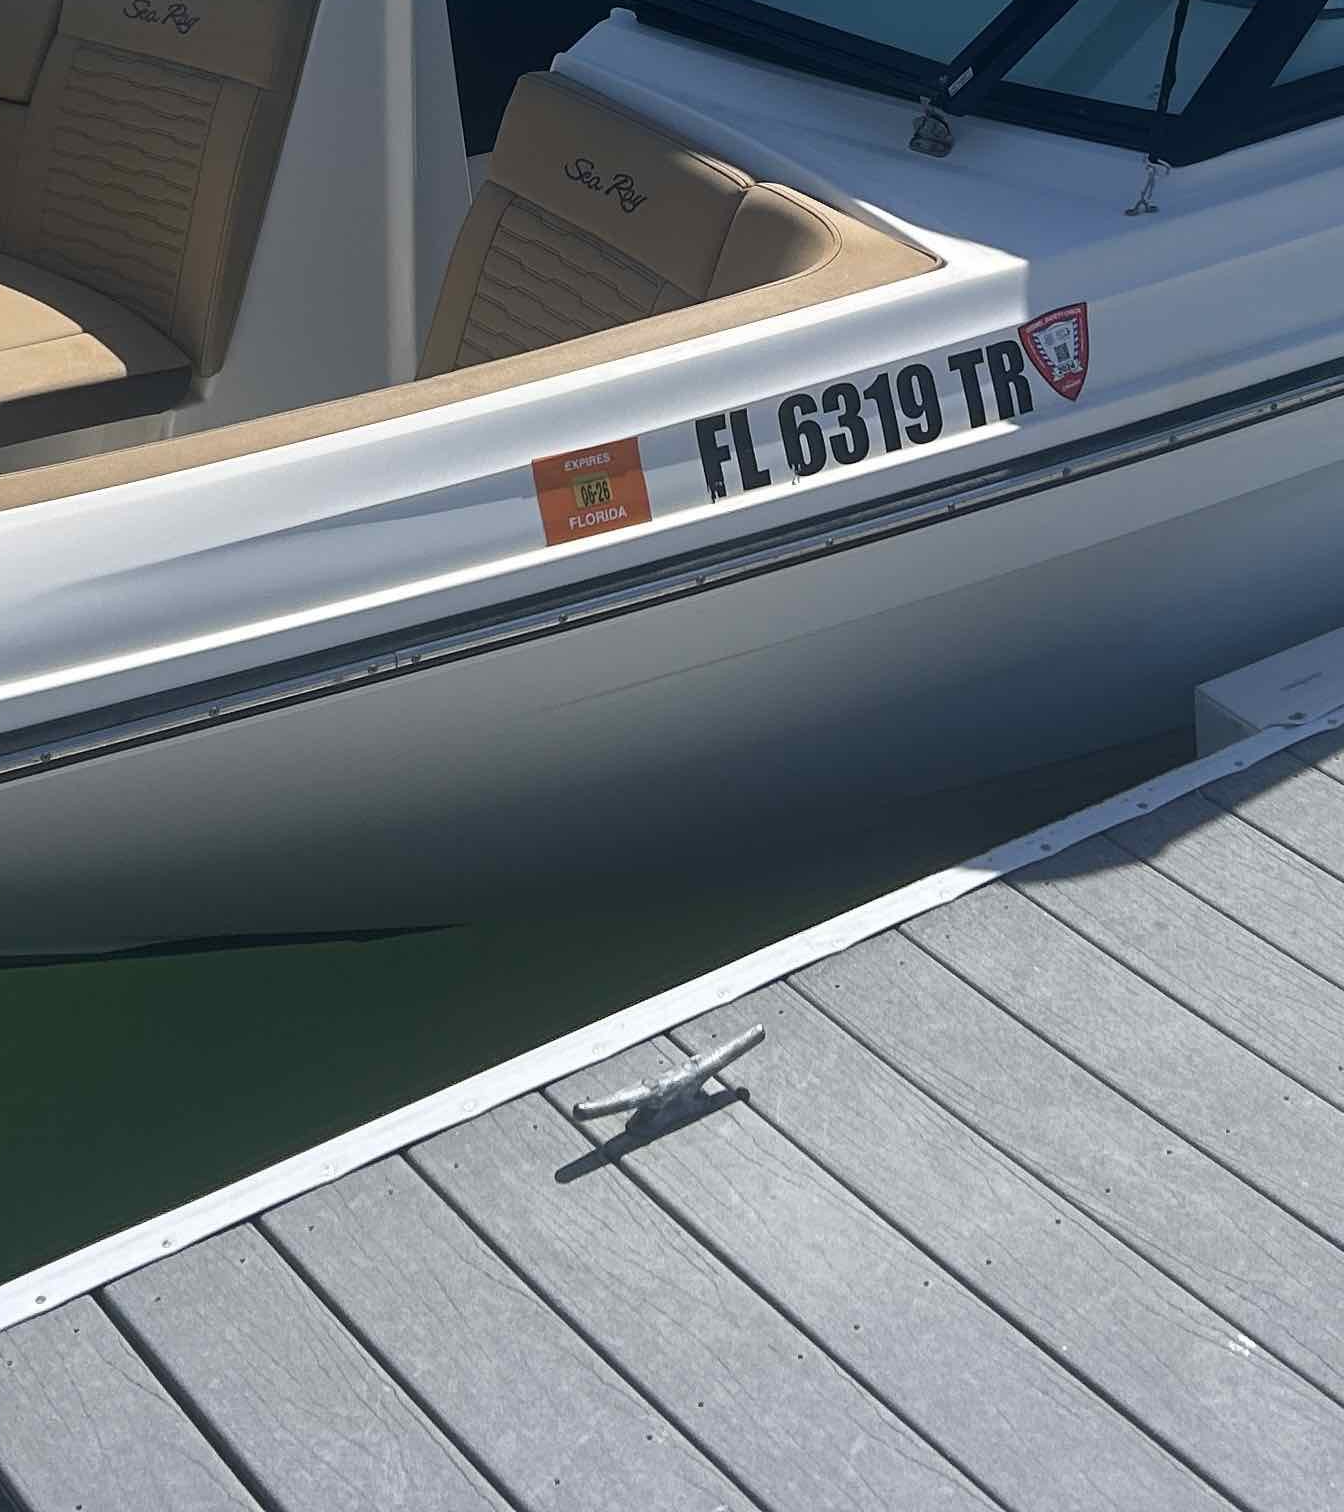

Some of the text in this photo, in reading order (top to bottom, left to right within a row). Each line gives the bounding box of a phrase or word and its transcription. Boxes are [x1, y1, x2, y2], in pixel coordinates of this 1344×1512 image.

[123, 0, 200, 34] Sea Ray
[564, 158, 648, 213] Sea Ray
[695, 339, 1035, 504] FL 6319 TR
[563, 452, 611, 471] EXPIRES
[568, 506, 628, 530] FLORIDA
